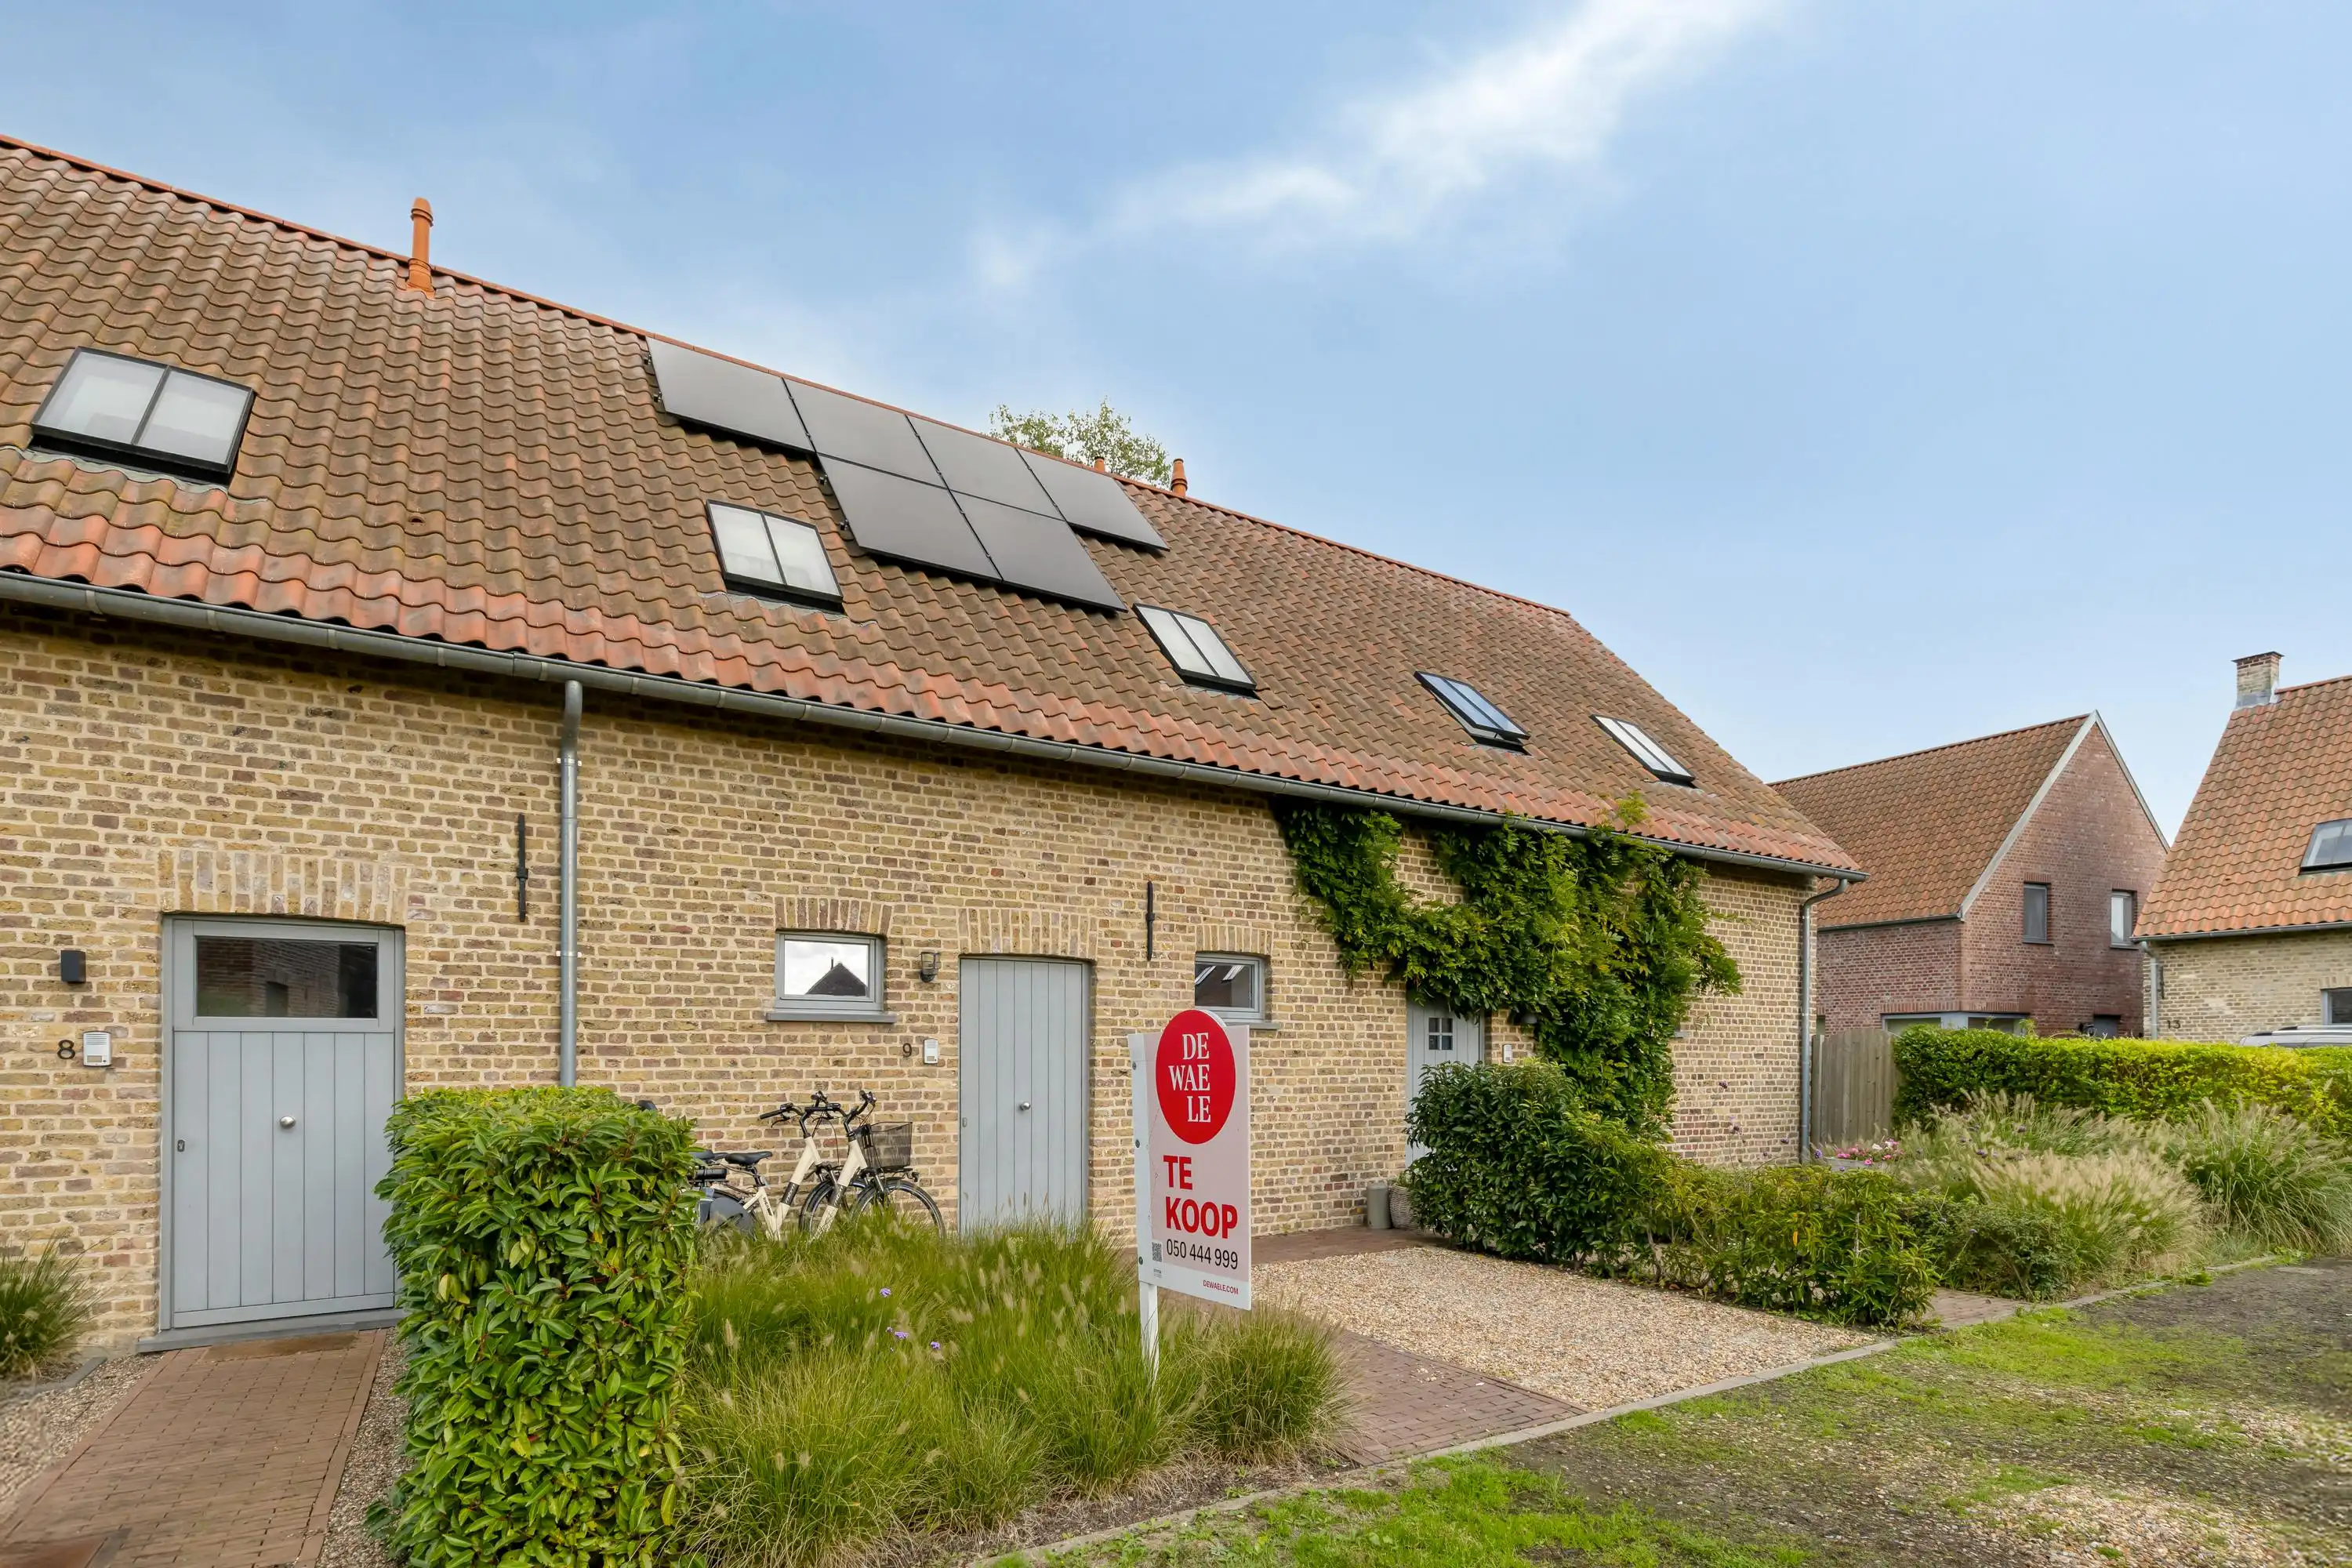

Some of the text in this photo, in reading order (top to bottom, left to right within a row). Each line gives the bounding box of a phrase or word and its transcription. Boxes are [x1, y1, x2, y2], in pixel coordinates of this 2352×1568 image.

[2167, 1019, 2181, 1029] 13
[56, 1039, 76, 1060] 8
[902, 1043, 913, 1058] 9
[1181, 1032, 1210, 1060] DE
[1167, 1064, 1210, 1091] WAE
[1186, 1095, 1211, 1123] LE
[1163, 1154, 1193, 1190] TE
[1165, 1196, 1238, 1240] KOOP
[1166, 1238, 1238, 1270] 050 444 999
[1203, 1279, 1239, 1295] DEWAELE.COM
